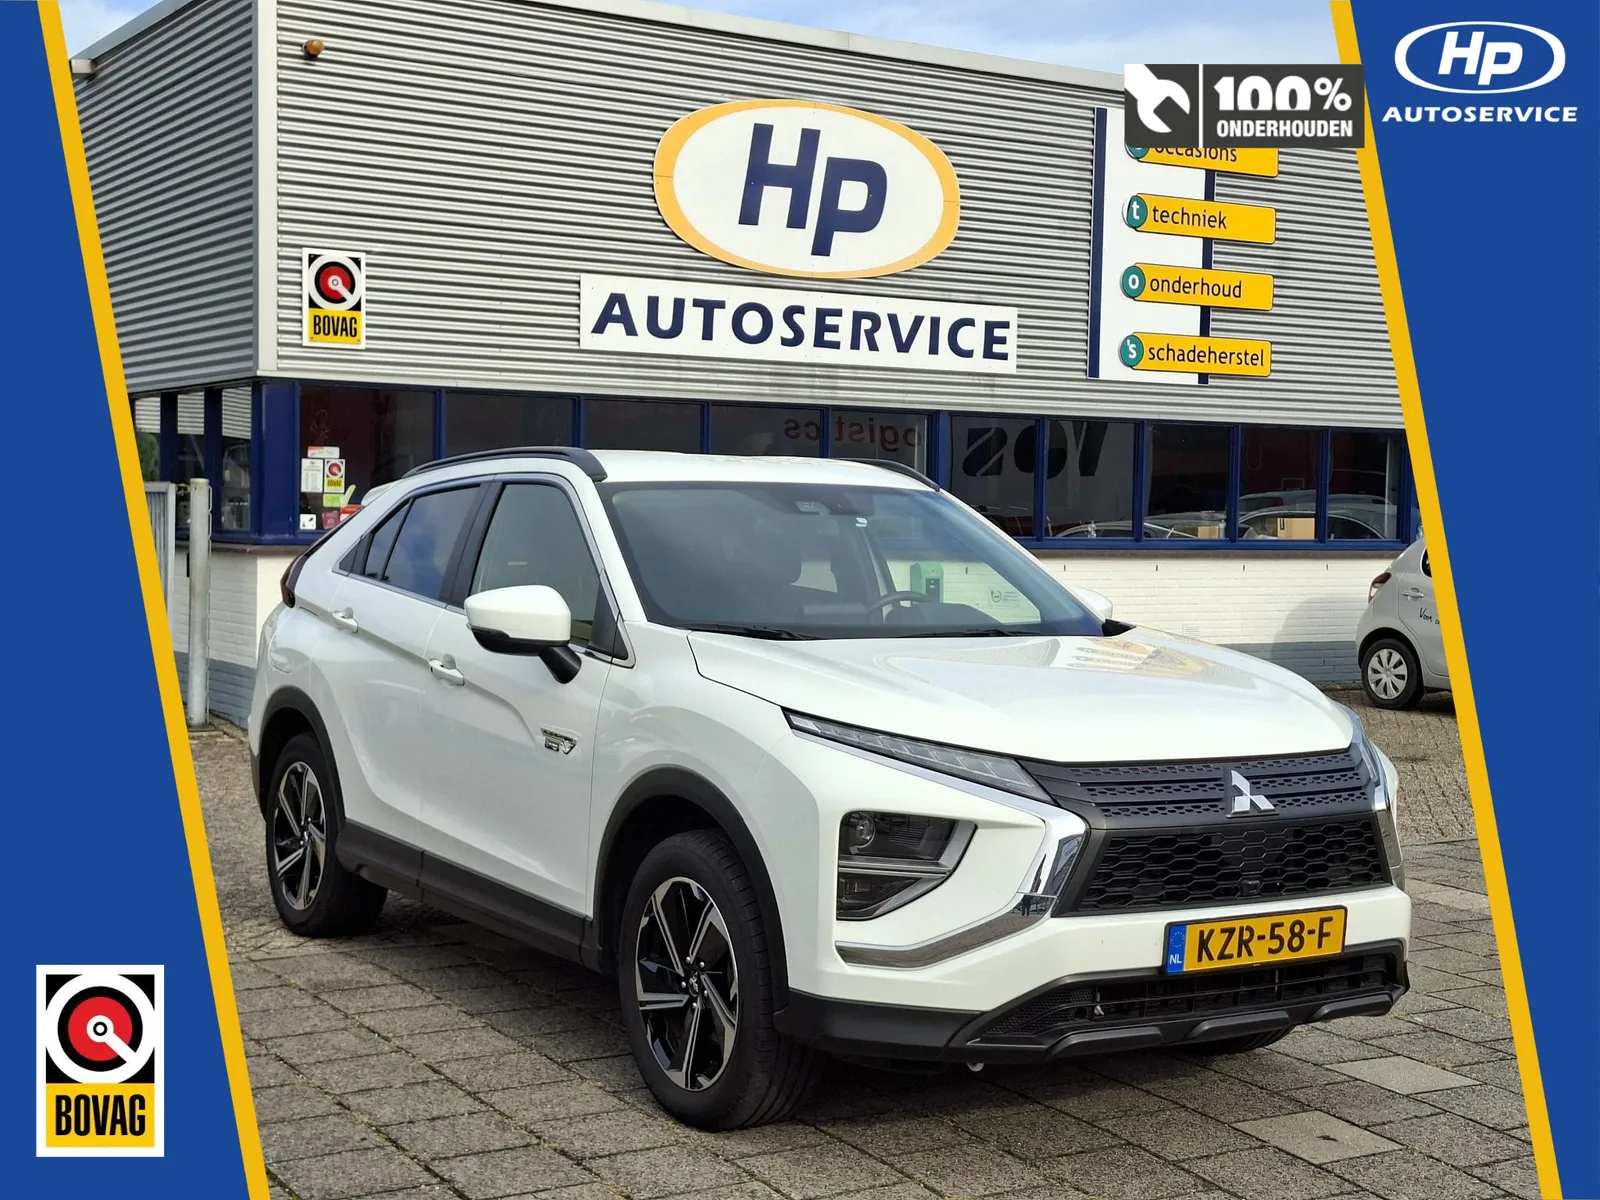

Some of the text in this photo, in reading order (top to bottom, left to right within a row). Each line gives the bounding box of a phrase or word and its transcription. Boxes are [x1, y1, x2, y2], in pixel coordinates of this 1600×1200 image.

[1152, 205, 1228, 229] techniek
[1150, 275, 1242, 298] onderhoud
[313, 314, 358, 338] BOVAG
[590, 292, 1011, 361] AUTOSERVICE
[1148, 343, 1264, 367] schadeherstel
[1169, 916, 1334, 965] NL KZR-58-F
